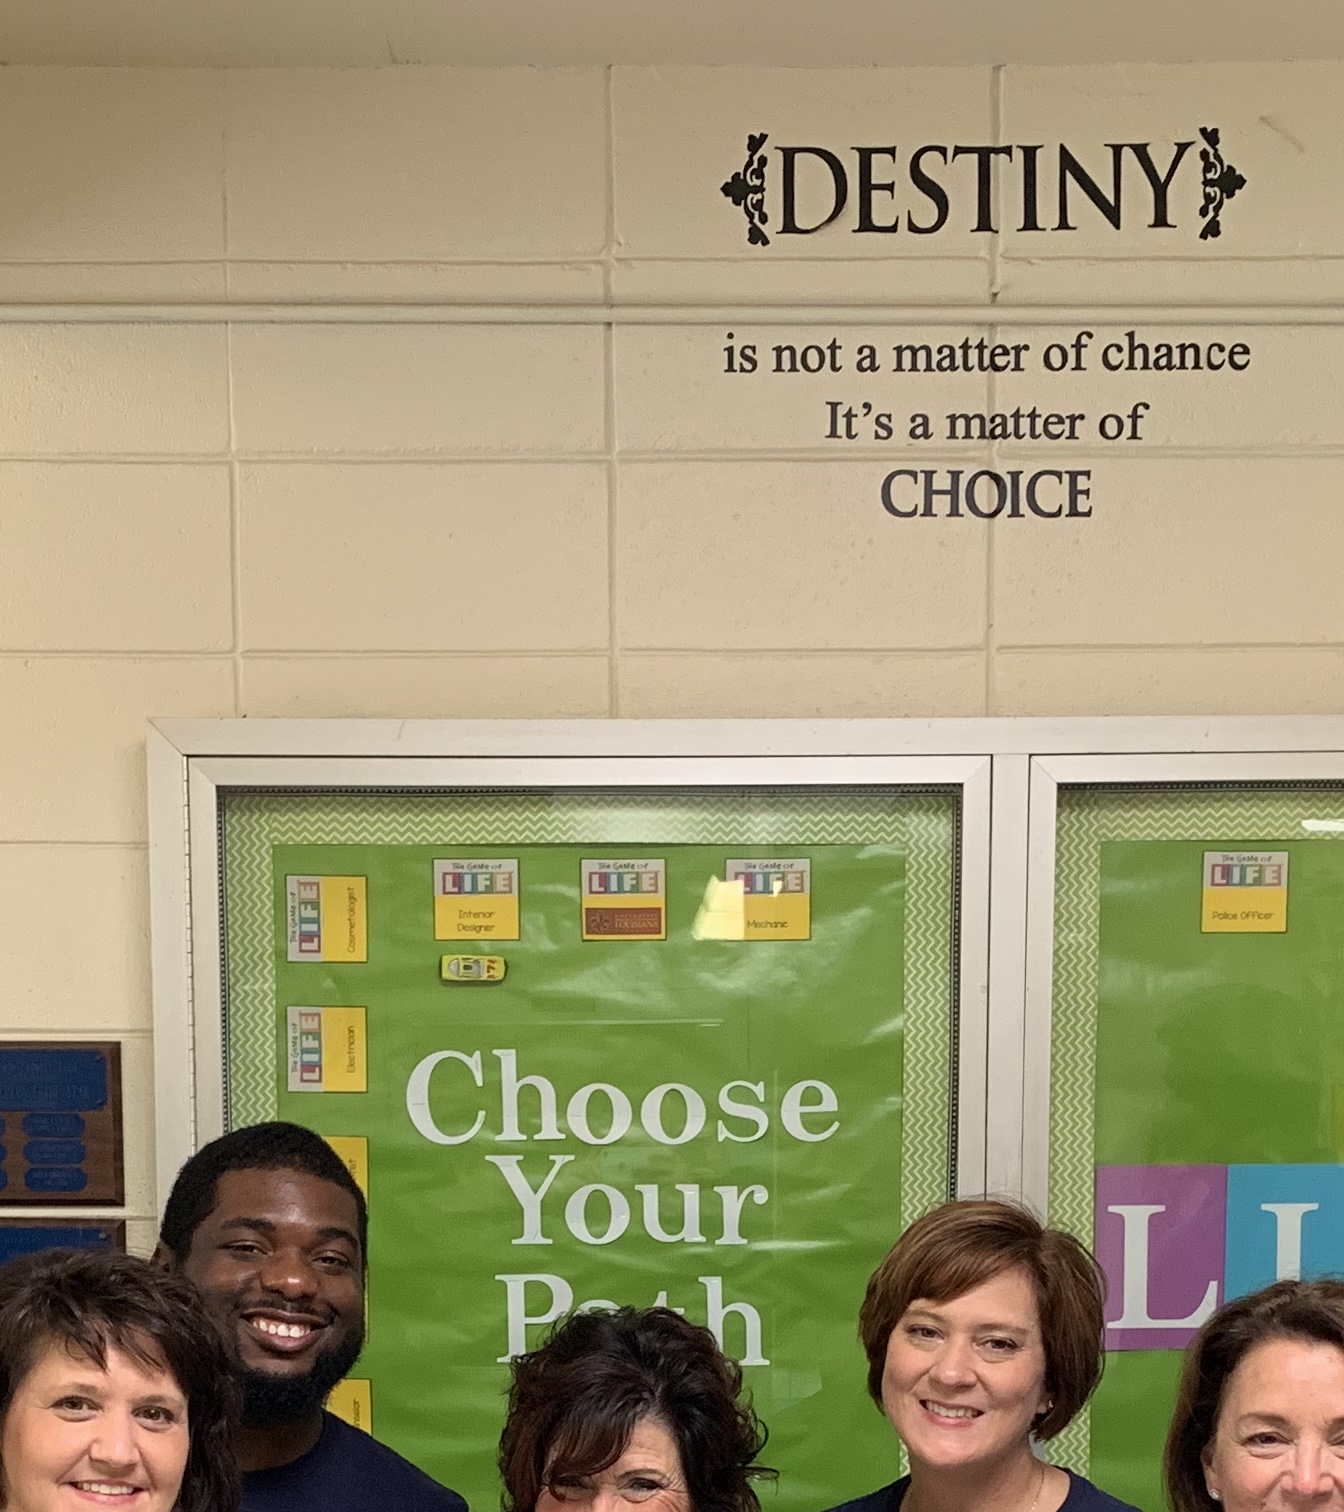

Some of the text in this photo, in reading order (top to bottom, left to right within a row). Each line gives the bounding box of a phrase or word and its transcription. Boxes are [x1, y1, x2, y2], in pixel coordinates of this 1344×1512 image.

[774, 141, 1197, 236] DESTINY
[723, 332, 1251, 373] is not a matter of chance
[908, 413, 933, 440] a
[946, 405, 1085, 441] matter
[1098, 402, 1150, 441] of
[880, 470, 1092, 519] CHOICE
[405, 1048, 840, 1145] Choose
[484, 1154, 769, 1246] Your
[494, 1273, 770, 1366] Ph
